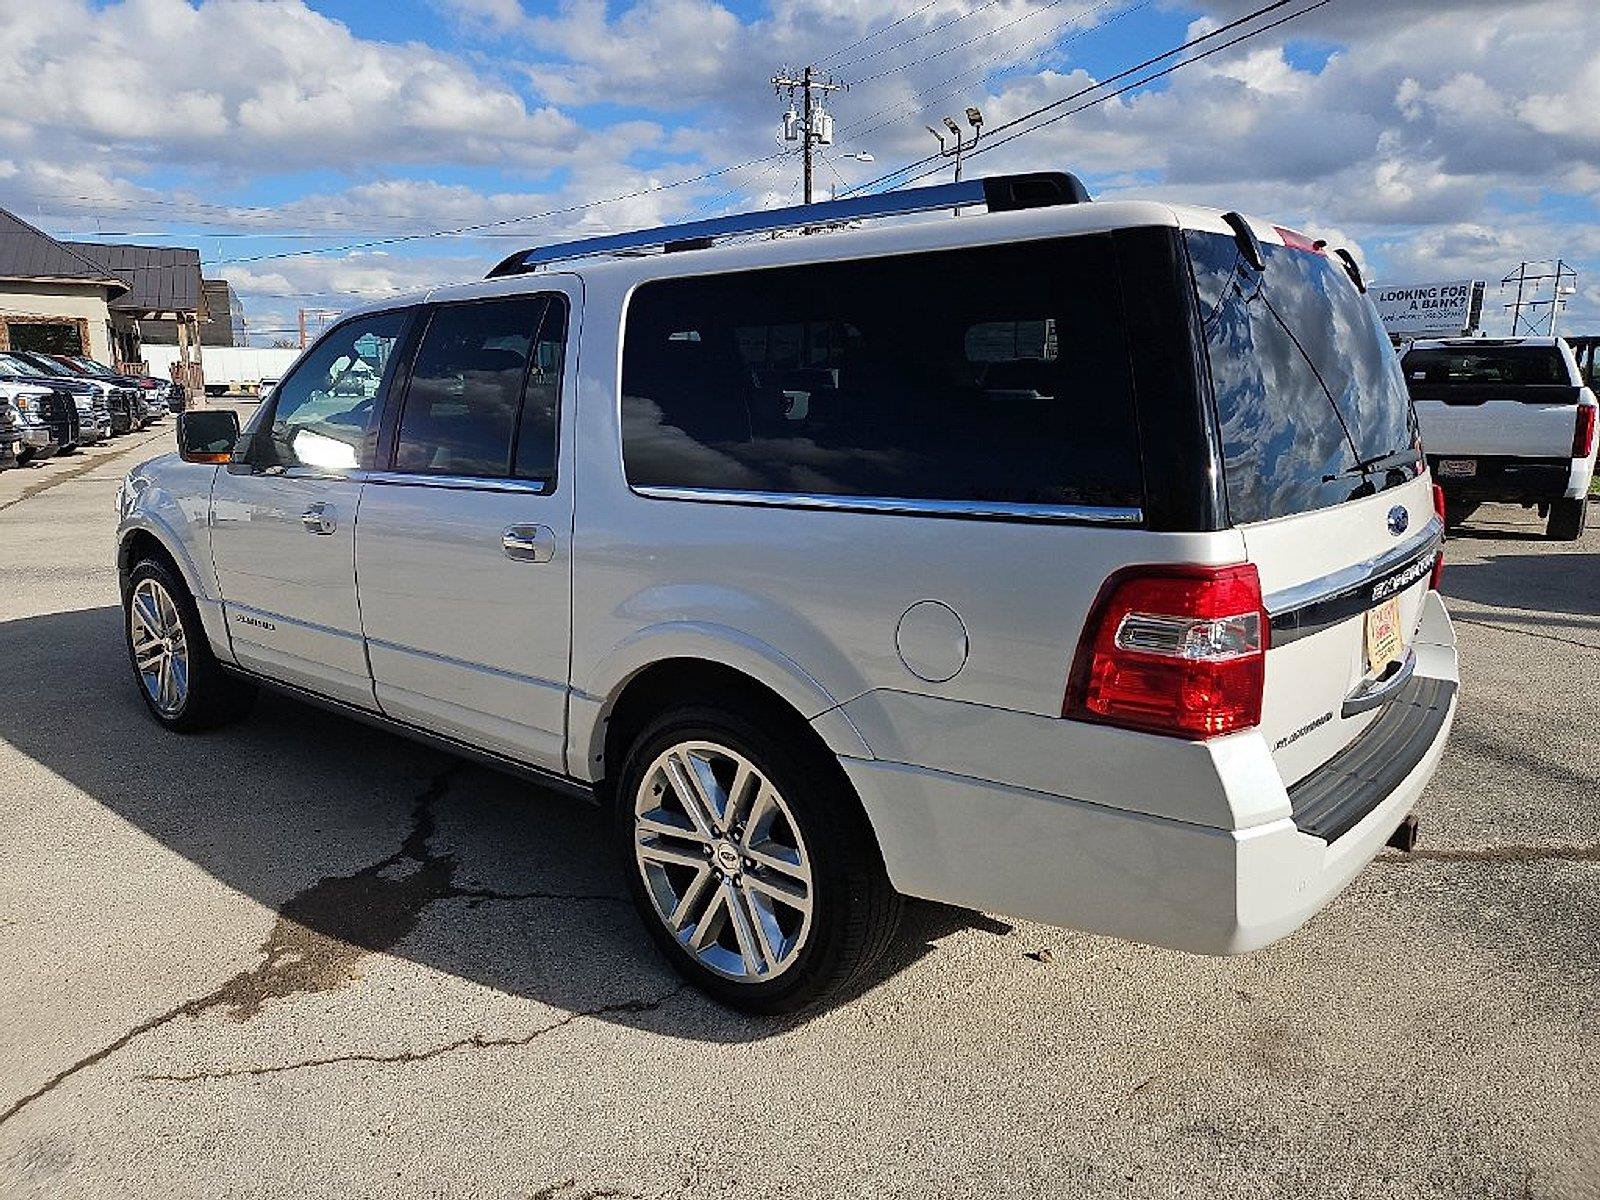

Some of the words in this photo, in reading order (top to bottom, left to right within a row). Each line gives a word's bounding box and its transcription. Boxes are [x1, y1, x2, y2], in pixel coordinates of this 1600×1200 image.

[1380, 288, 1437, 301] LOOKING
[1441, 286, 1467, 297] FOR
[1409, 300, 1418, 310] A
[1422, 297, 1466, 309] BANK?
